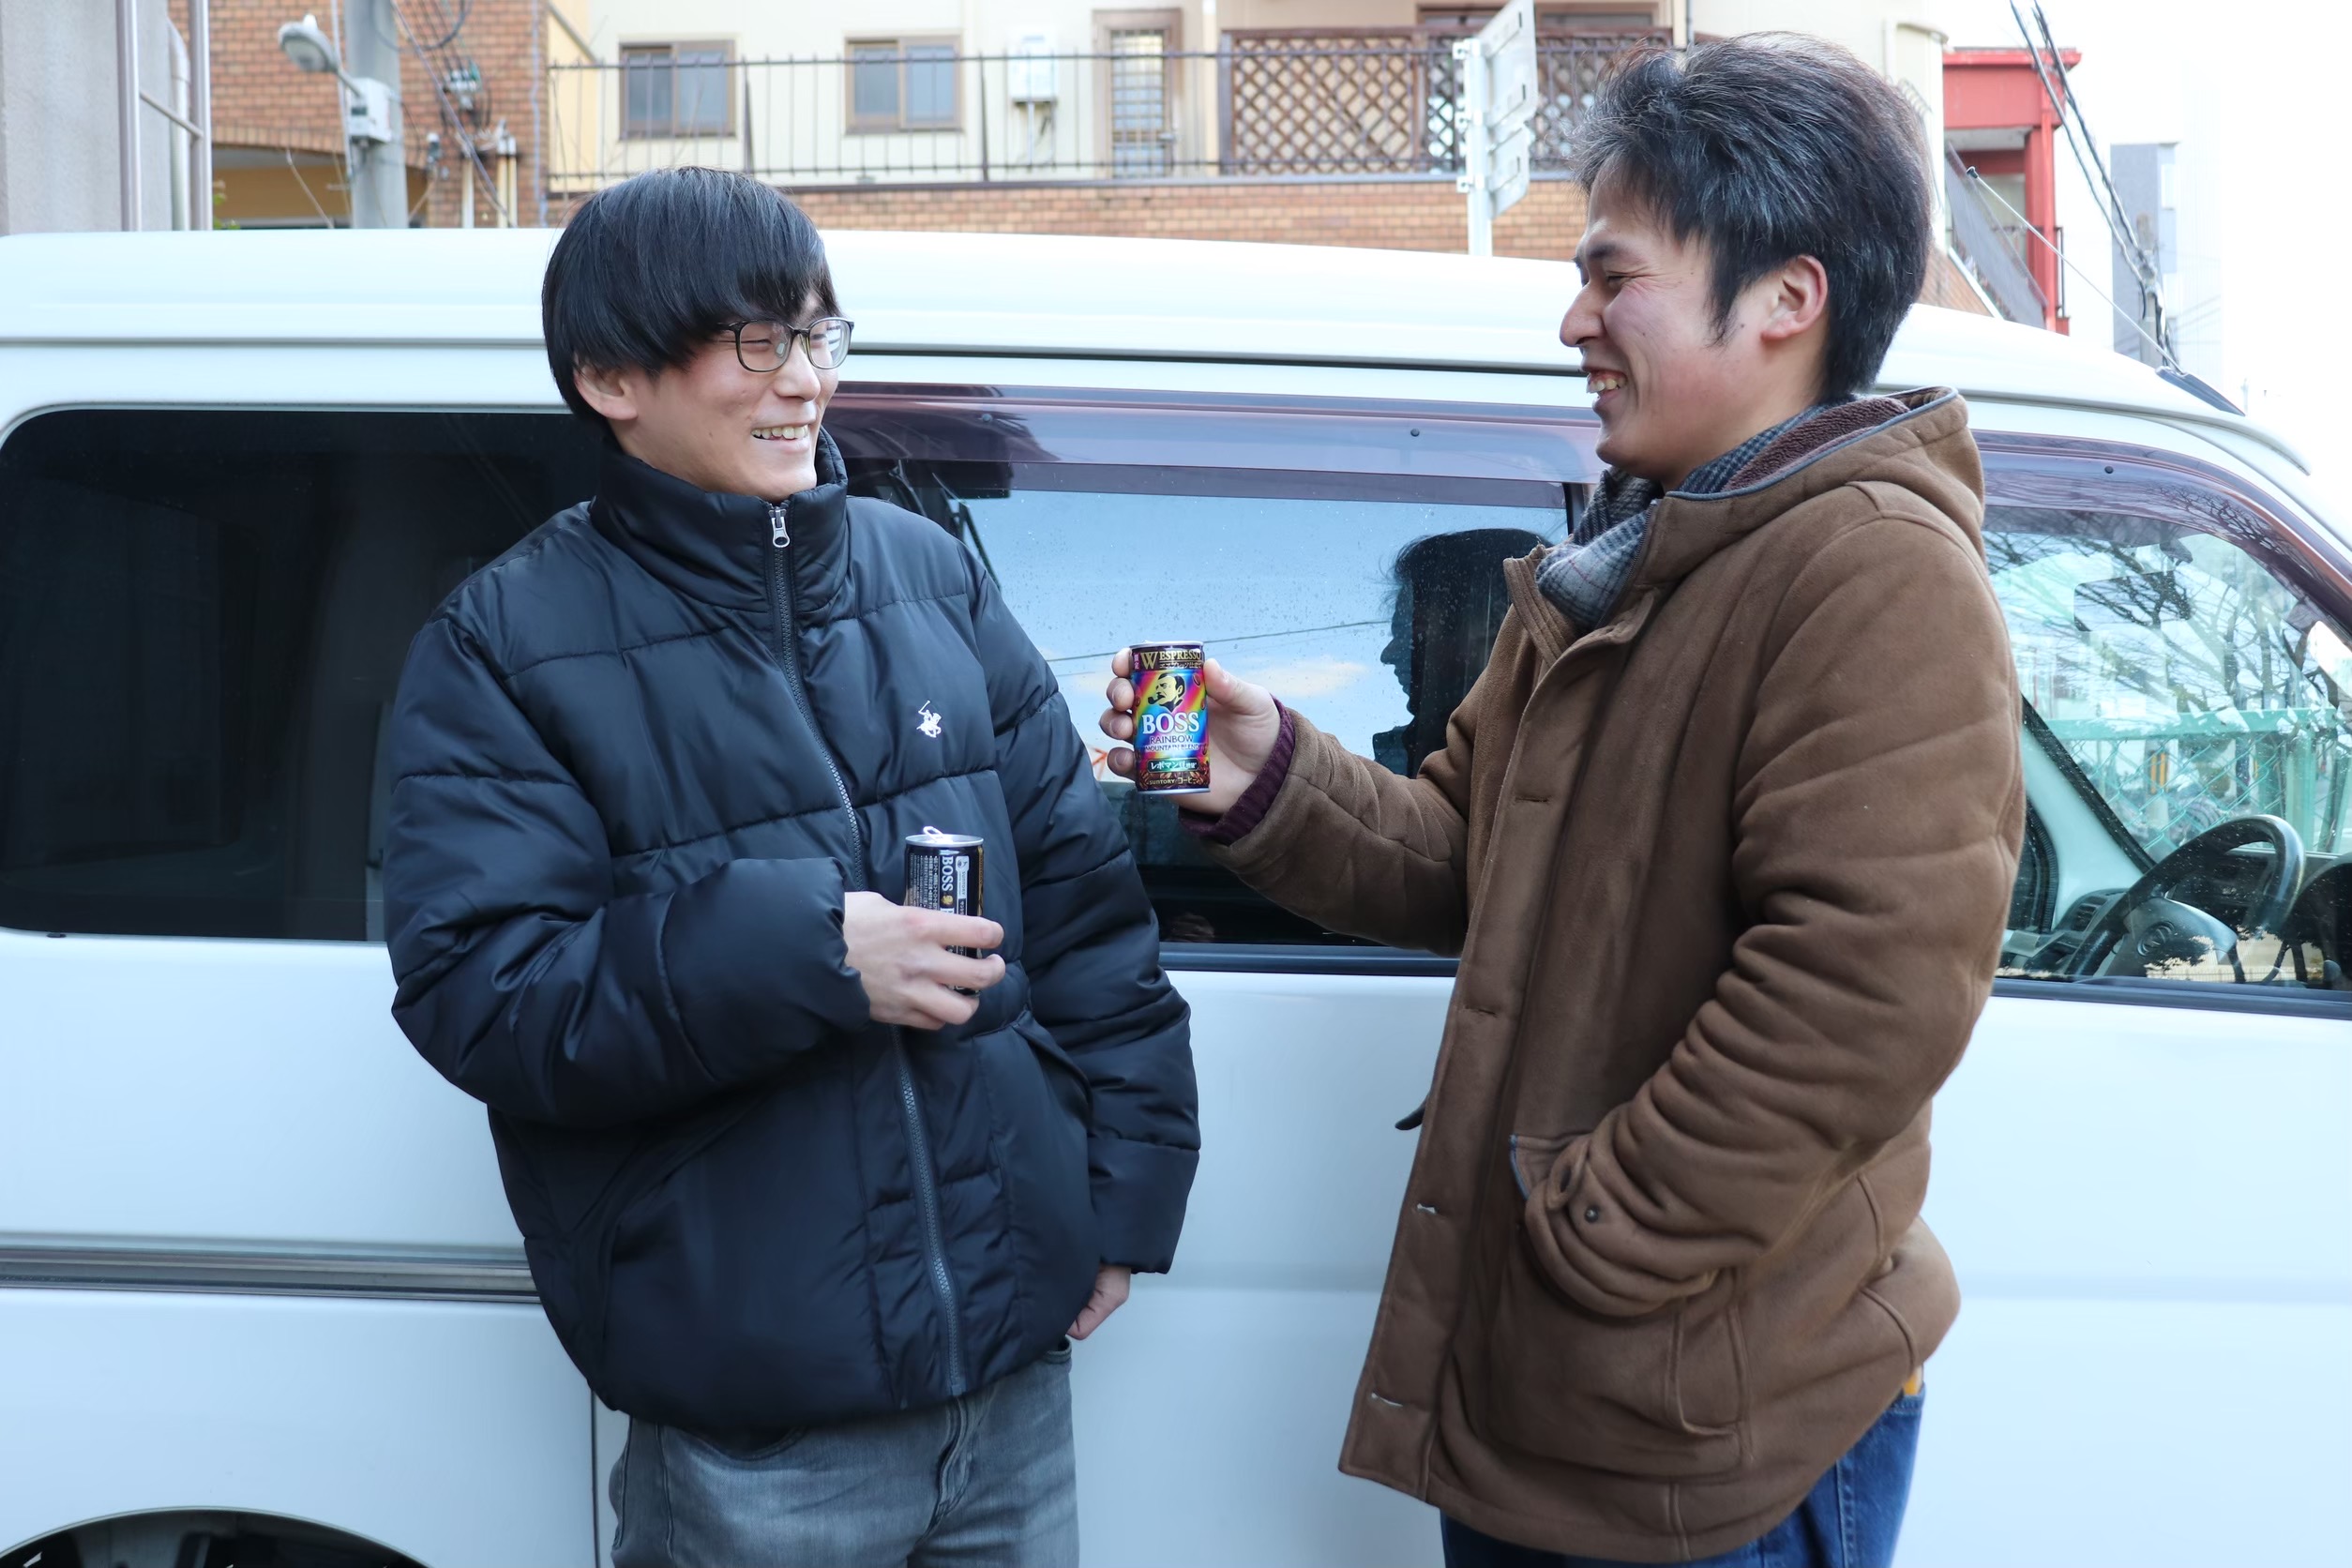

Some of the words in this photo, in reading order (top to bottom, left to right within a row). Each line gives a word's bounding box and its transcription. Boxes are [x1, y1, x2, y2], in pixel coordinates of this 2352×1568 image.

[1140, 651, 1158, 670] W
[1159, 650, 1201, 660] ESPRESSO
[1142, 712, 1200, 734] BOSS
[1150, 735, 1194, 744] RAINBOW
[942, 855, 954, 891] BOSS
